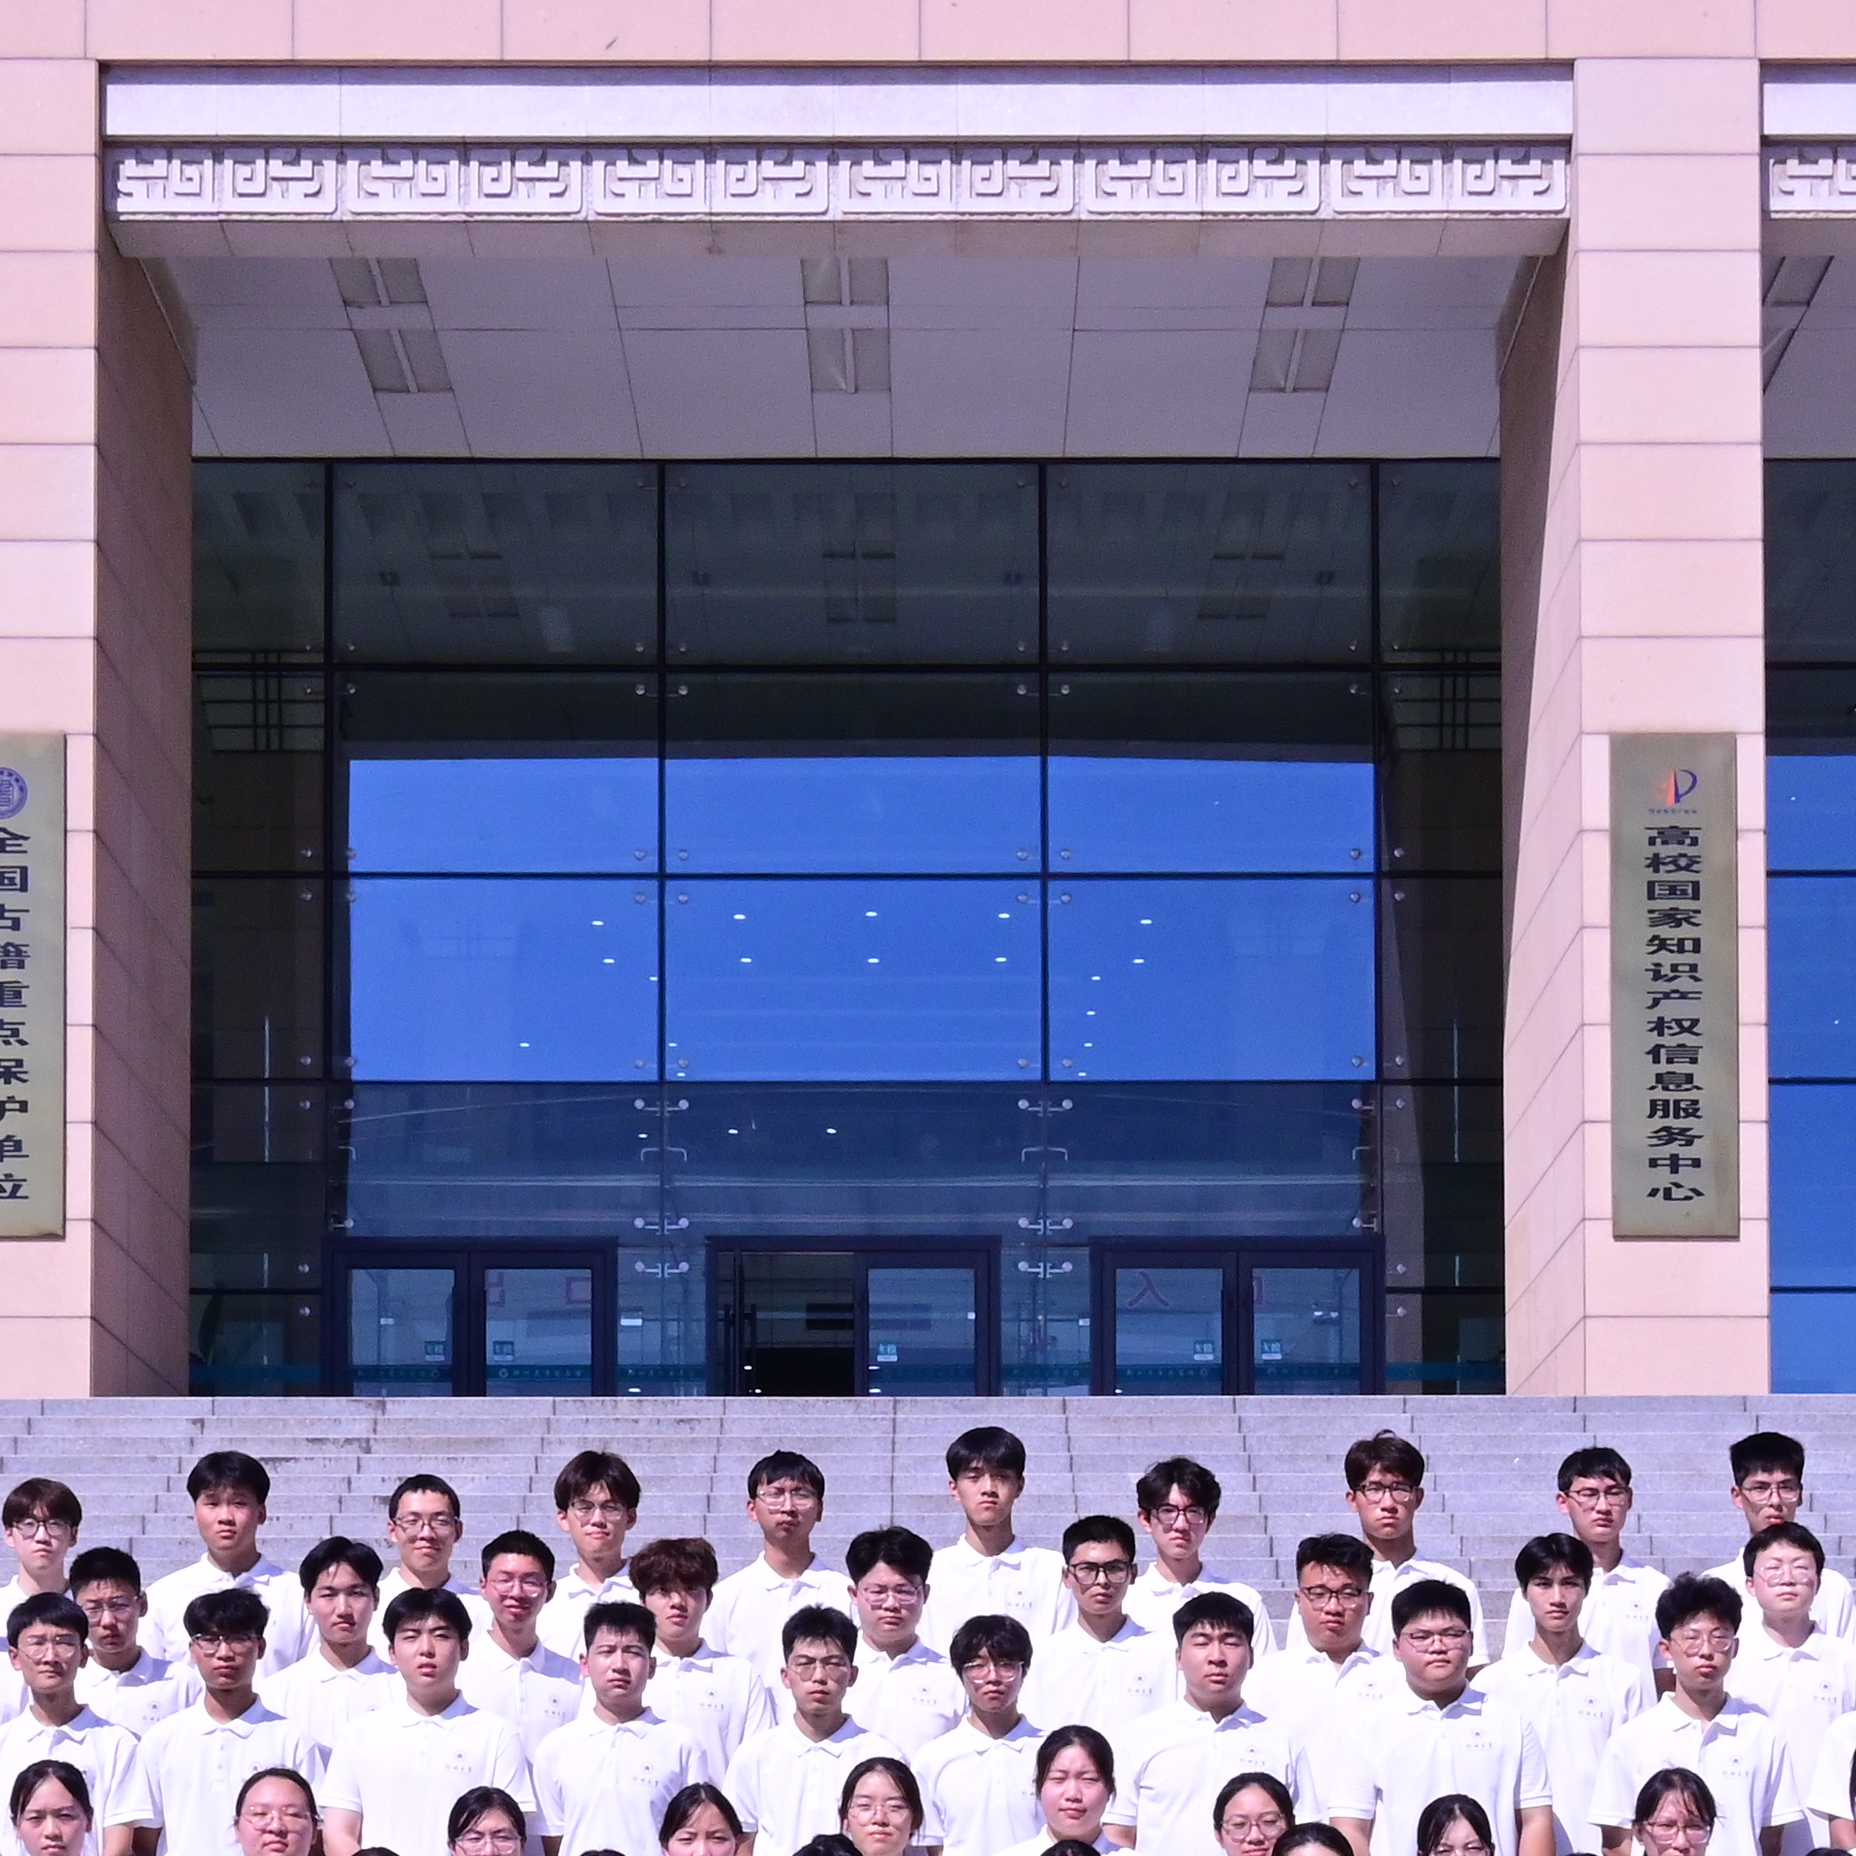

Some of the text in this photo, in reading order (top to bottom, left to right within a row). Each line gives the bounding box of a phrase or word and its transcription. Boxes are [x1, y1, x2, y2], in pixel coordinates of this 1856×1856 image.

[1643, 825, 1705, 1202] 高校国家知识产权信息服务中心
